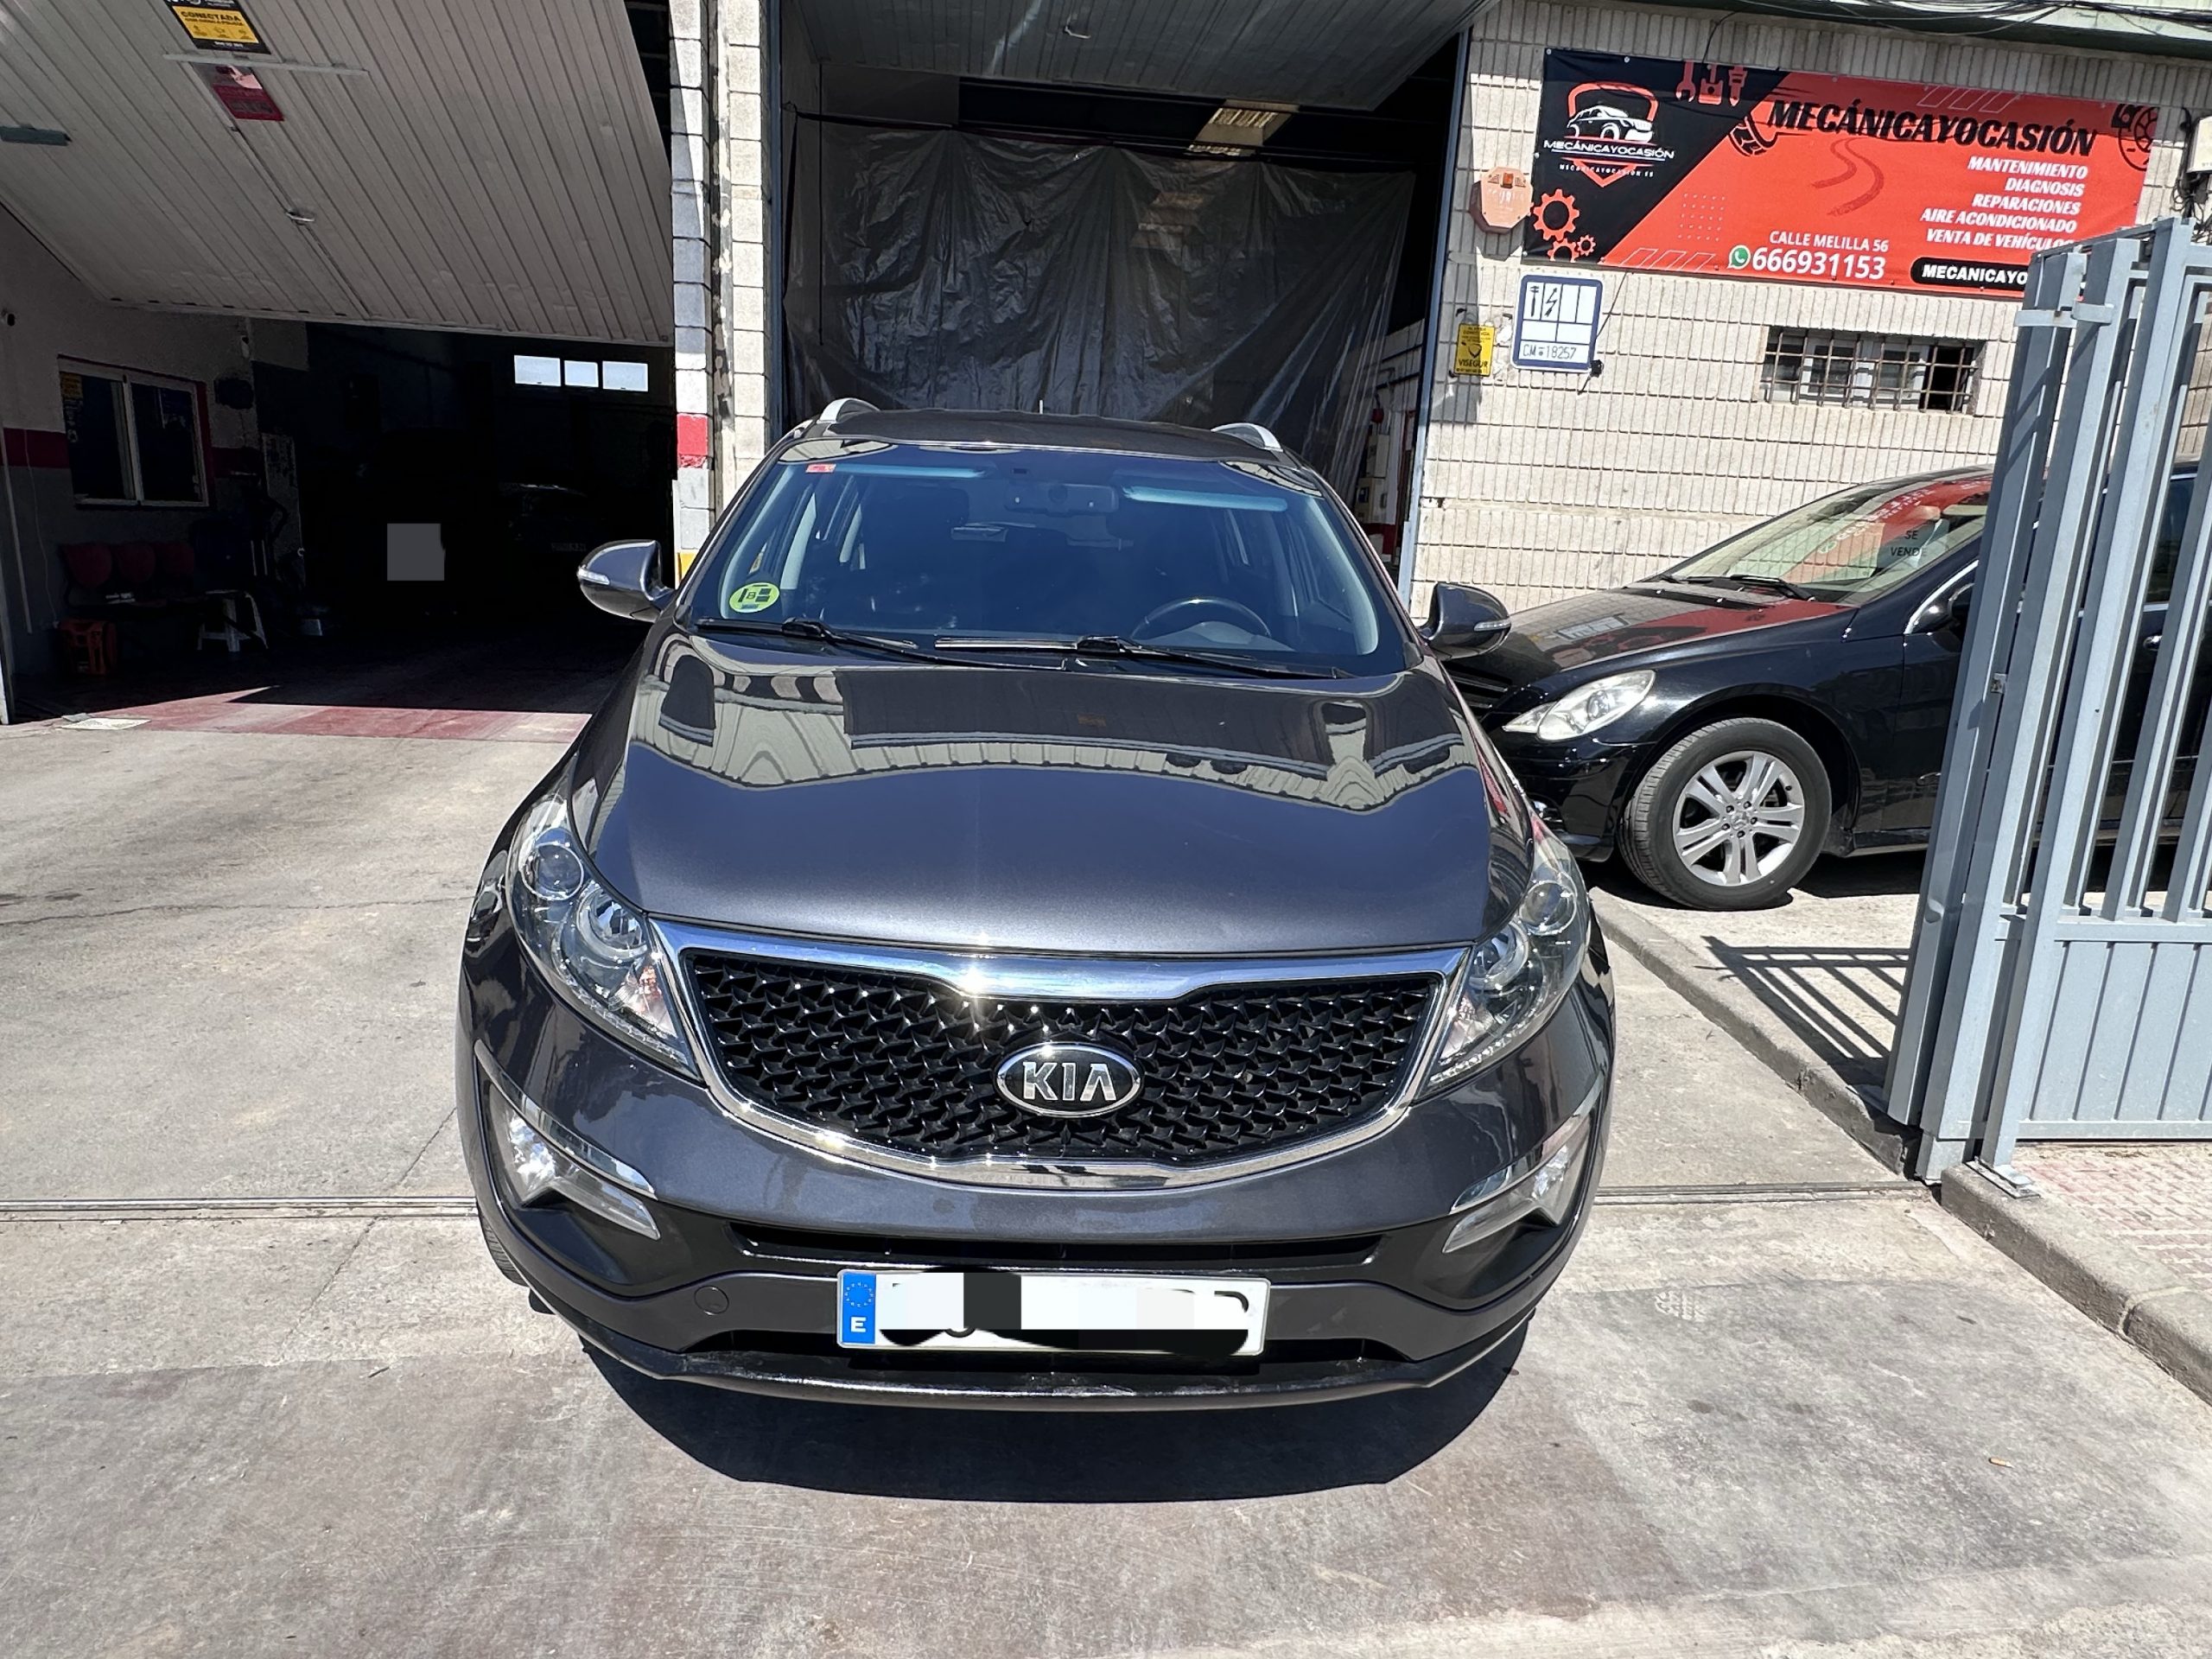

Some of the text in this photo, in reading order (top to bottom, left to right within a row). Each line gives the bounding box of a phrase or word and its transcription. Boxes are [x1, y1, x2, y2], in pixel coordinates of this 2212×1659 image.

[1767, 99, 2098, 156] MECÁNICAYOCASIÓN
[1543, 139, 1675, 159] MECÁNICAYOCASIÓN
[1967, 156, 2088, 180] MANTENIMIENTO
[2005, 177, 2086, 198] DIAGNOSIS
[1971, 194, 2082, 215] REPARACIONES
[1920, 207, 2077, 234] AIRE ACONDICIONADO
[1770, 231, 1890, 253] CALLE MELILLA 56
[1926, 228, 1971, 245] VENTA
[1973, 233, 1992, 247] DE
[1751, 246, 1886, 280] 666931153
[1904, 530, 1918, 540] SE
[1891, 546, 1928, 556] VENDE
[1023, 1062, 1117, 1102] KIA
[850, 1316, 867, 1332] E
